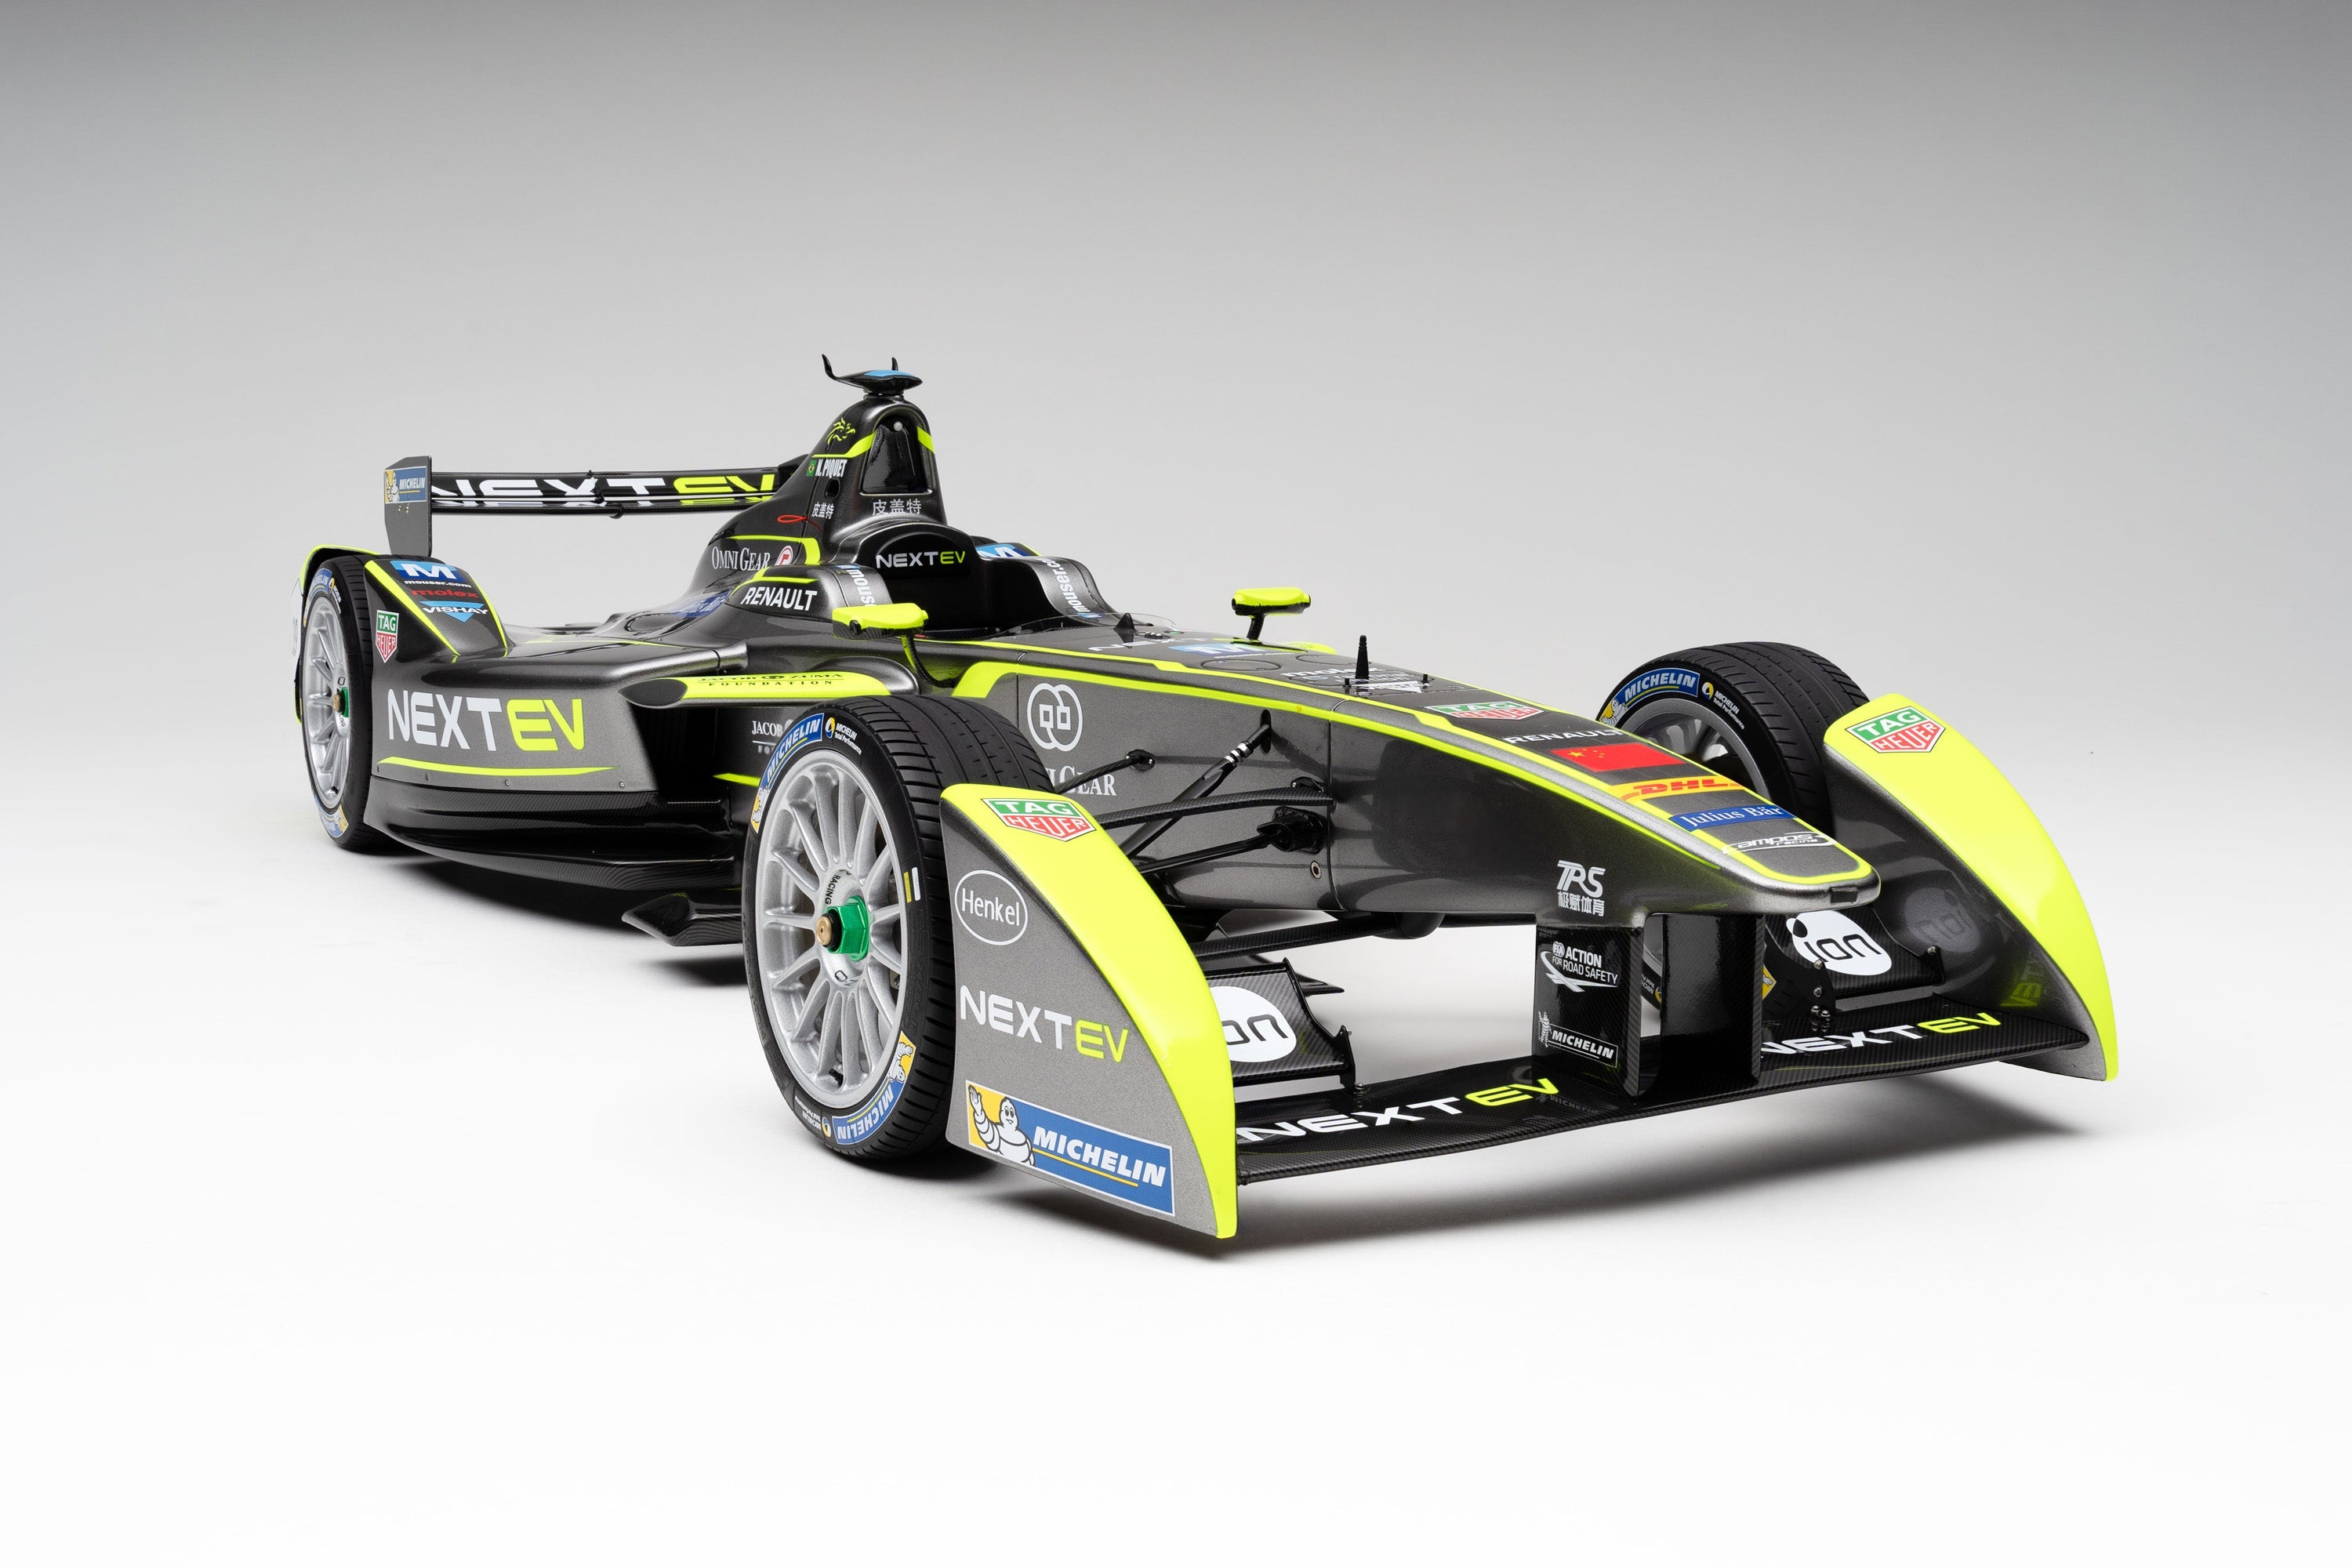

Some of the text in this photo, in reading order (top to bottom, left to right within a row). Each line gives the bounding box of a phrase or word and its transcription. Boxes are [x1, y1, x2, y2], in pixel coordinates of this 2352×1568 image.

[823, 459, 848, 478] PIQUET
[399, 477, 426, 490] MICHELIN
[811, 502, 834, 520] 皮盖特
[873, 499, 922, 515] 皮盖特
[876, 551, 965, 568] NEXTEV
[401, 564, 457, 579] M
[412, 590, 479, 598] molex
[740, 586, 817, 611] RENAULT
[846, 569, 876, 605] mous
[423, 606, 488, 615] VISHAY
[378, 615, 396, 632] TAG
[376, 633, 397, 653] HEUER
[1624, 673, 1697, 702] MICHELIN
[1715, 691, 1740, 714] MICHELIN
[387, 688, 584, 751] NEXTEV
[751, 720, 783, 737] JACOB
[1858, 711, 1921, 736] TAG
[836, 723, 858, 741] MICHELIN
[1502, 729, 1628, 744] RENAULT
[1875, 722, 1937, 749] HEUER
[767, 719, 822, 783] MICHELIN
[1633, 779, 1729, 795] DHL
[996, 801, 1075, 815] TAG
[1679, 804, 1784, 827] Julius Bär
[1007, 815, 1091, 837] HEUER
[825, 874, 841, 905] RACING
[961, 887, 1020, 927] Henkel
[1566, 946, 1602, 968] ACTION
[1803, 934, 1882, 963] ion
[1552, 956, 1618, 984] FOR ROAD SAFETY
[960, 985, 1129, 1062] NEXTEV
[1221, 1014, 1288, 1045] on
[1552, 1029, 1615, 1059] MICHELIN
[837, 1083, 895, 1140] MICHELIN
[1236, 1078, 1559, 1142] NEXTEV
[1033, 1126, 1167, 1188] MICHELIN
